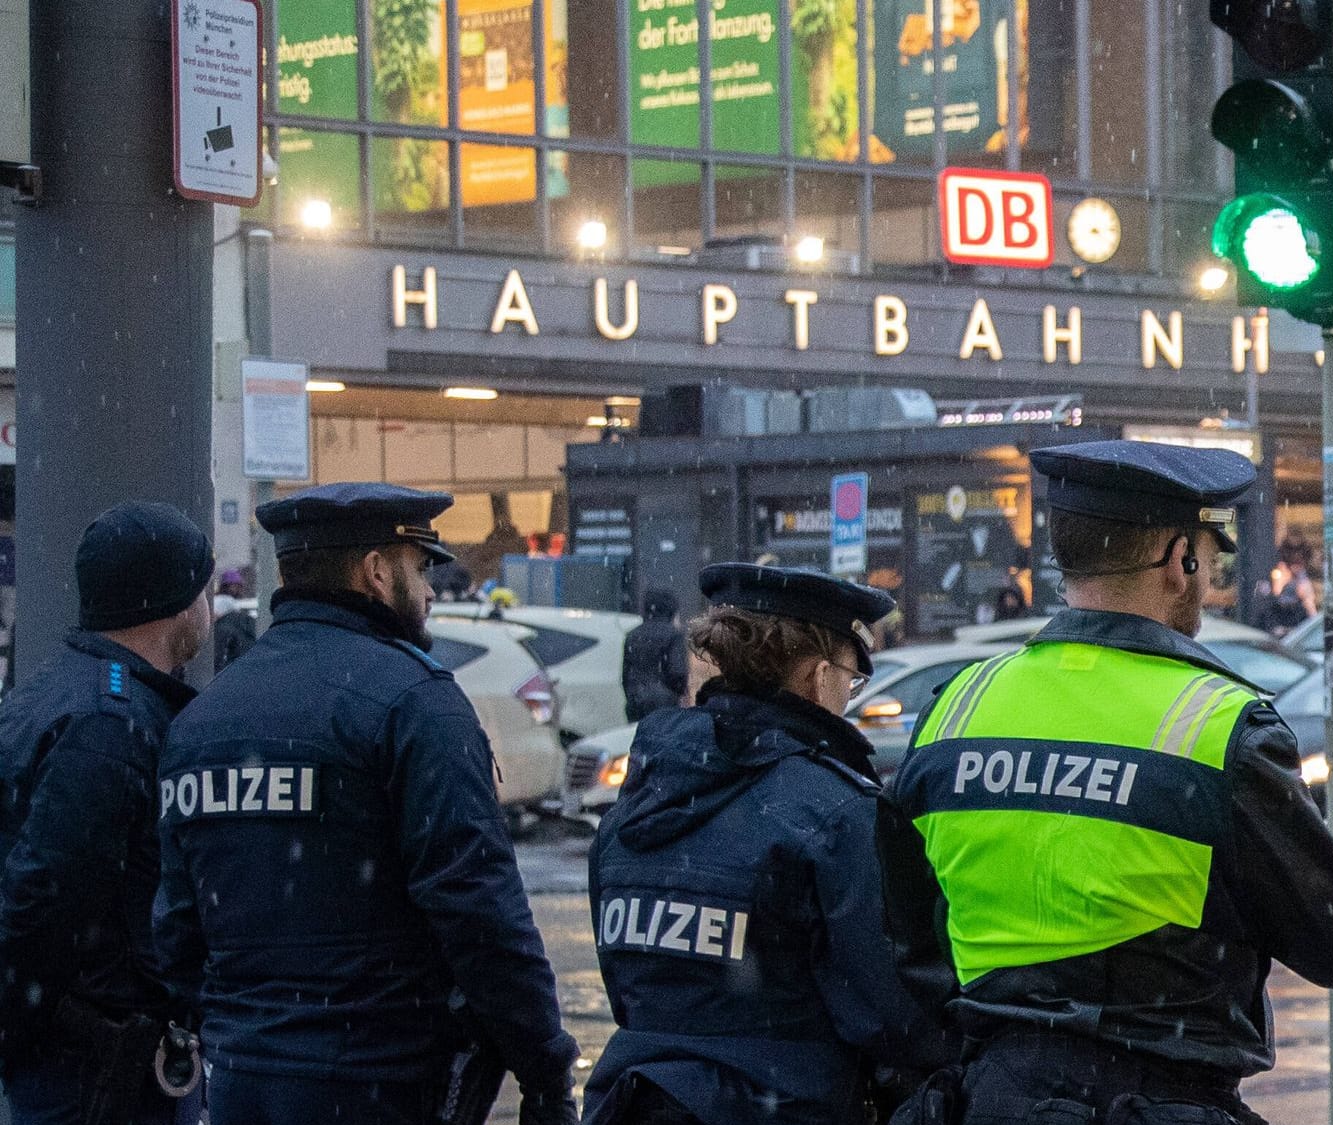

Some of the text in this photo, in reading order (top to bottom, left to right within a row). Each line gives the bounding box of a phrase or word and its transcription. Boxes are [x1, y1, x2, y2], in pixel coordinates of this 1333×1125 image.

[958, 187, 1038, 248] DB
[392, 264, 1322, 374] HAUPTBAHNH
[160, 767, 314, 819] POLIZEI
[954, 750, 1139, 806] POLIZEI
[598, 897, 749, 961] OLIZEI
